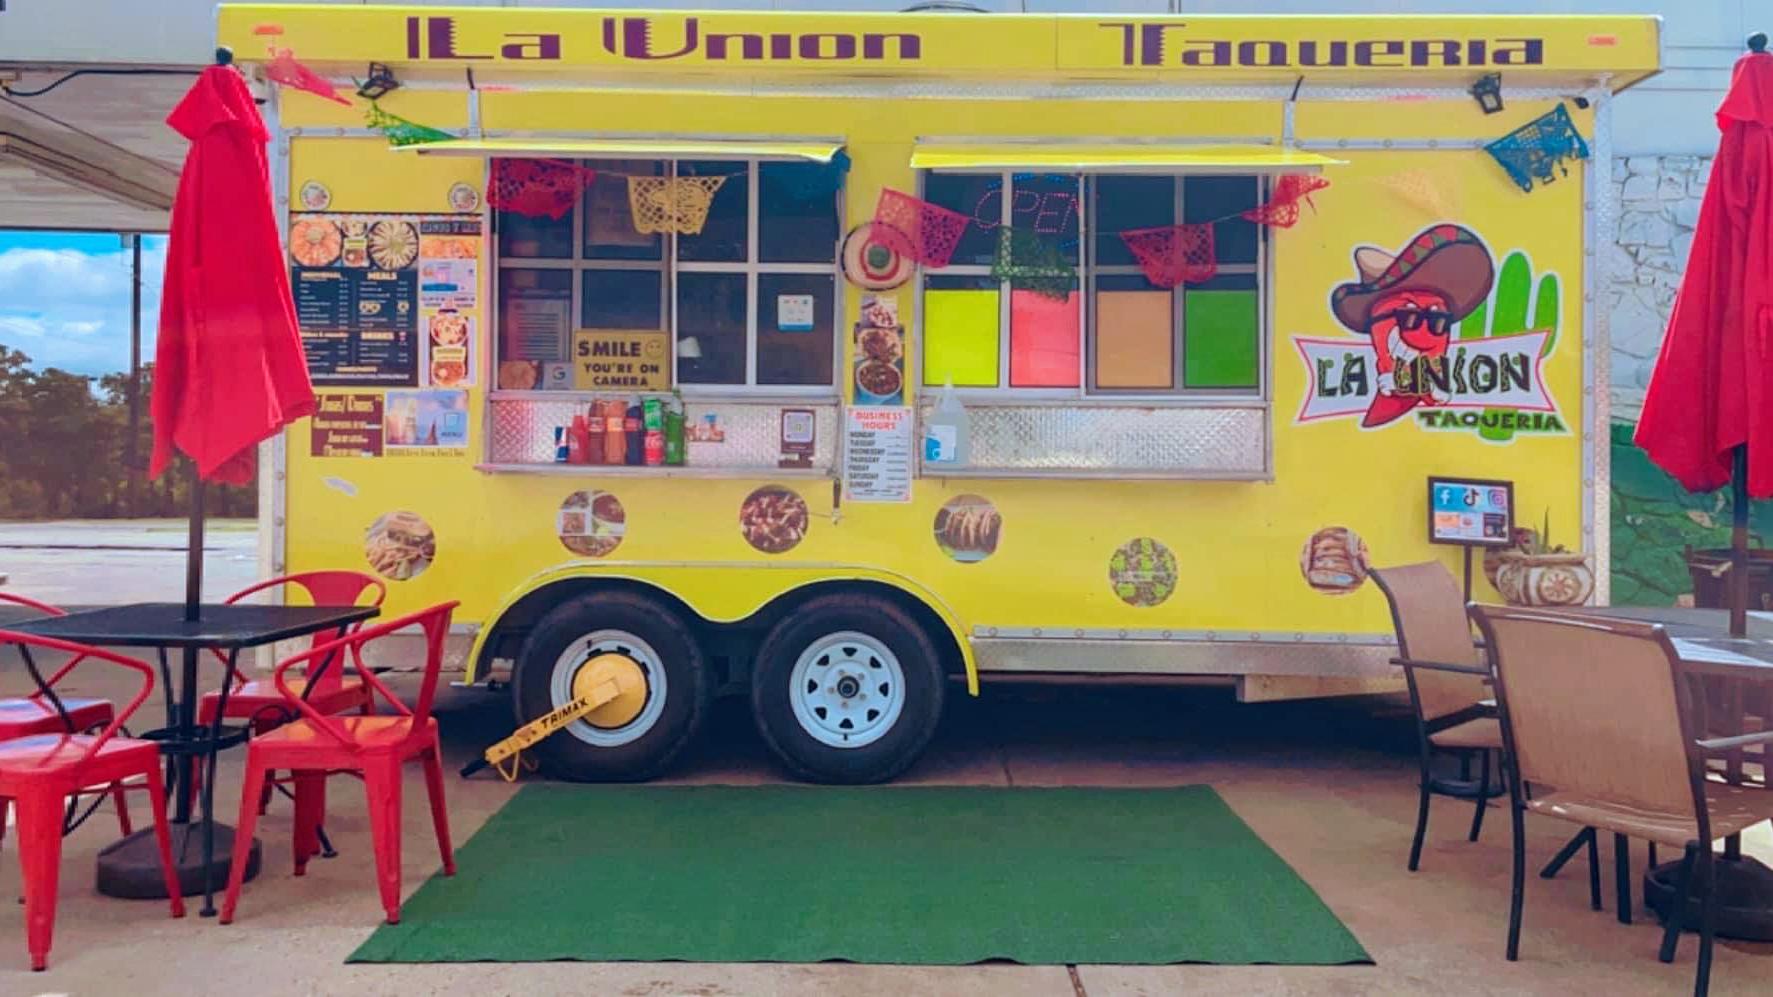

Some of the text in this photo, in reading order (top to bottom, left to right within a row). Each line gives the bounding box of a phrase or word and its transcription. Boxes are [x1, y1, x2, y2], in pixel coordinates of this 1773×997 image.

[407, 17, 560, 60] La
[603, 17, 921, 60] Union
[578, 340, 641, 357] SMILE
[584, 363, 659, 374] YOU'RE ON
[1317, 352, 1369, 398] LA
[593, 376, 649, 386] CAMERA
[856, 412, 902, 420] BUSINESS
[1418, 410, 1567, 431] TAQUERIA
[863, 422, 896, 430] HOURS
[541, 697, 589, 729] TRIMAX
